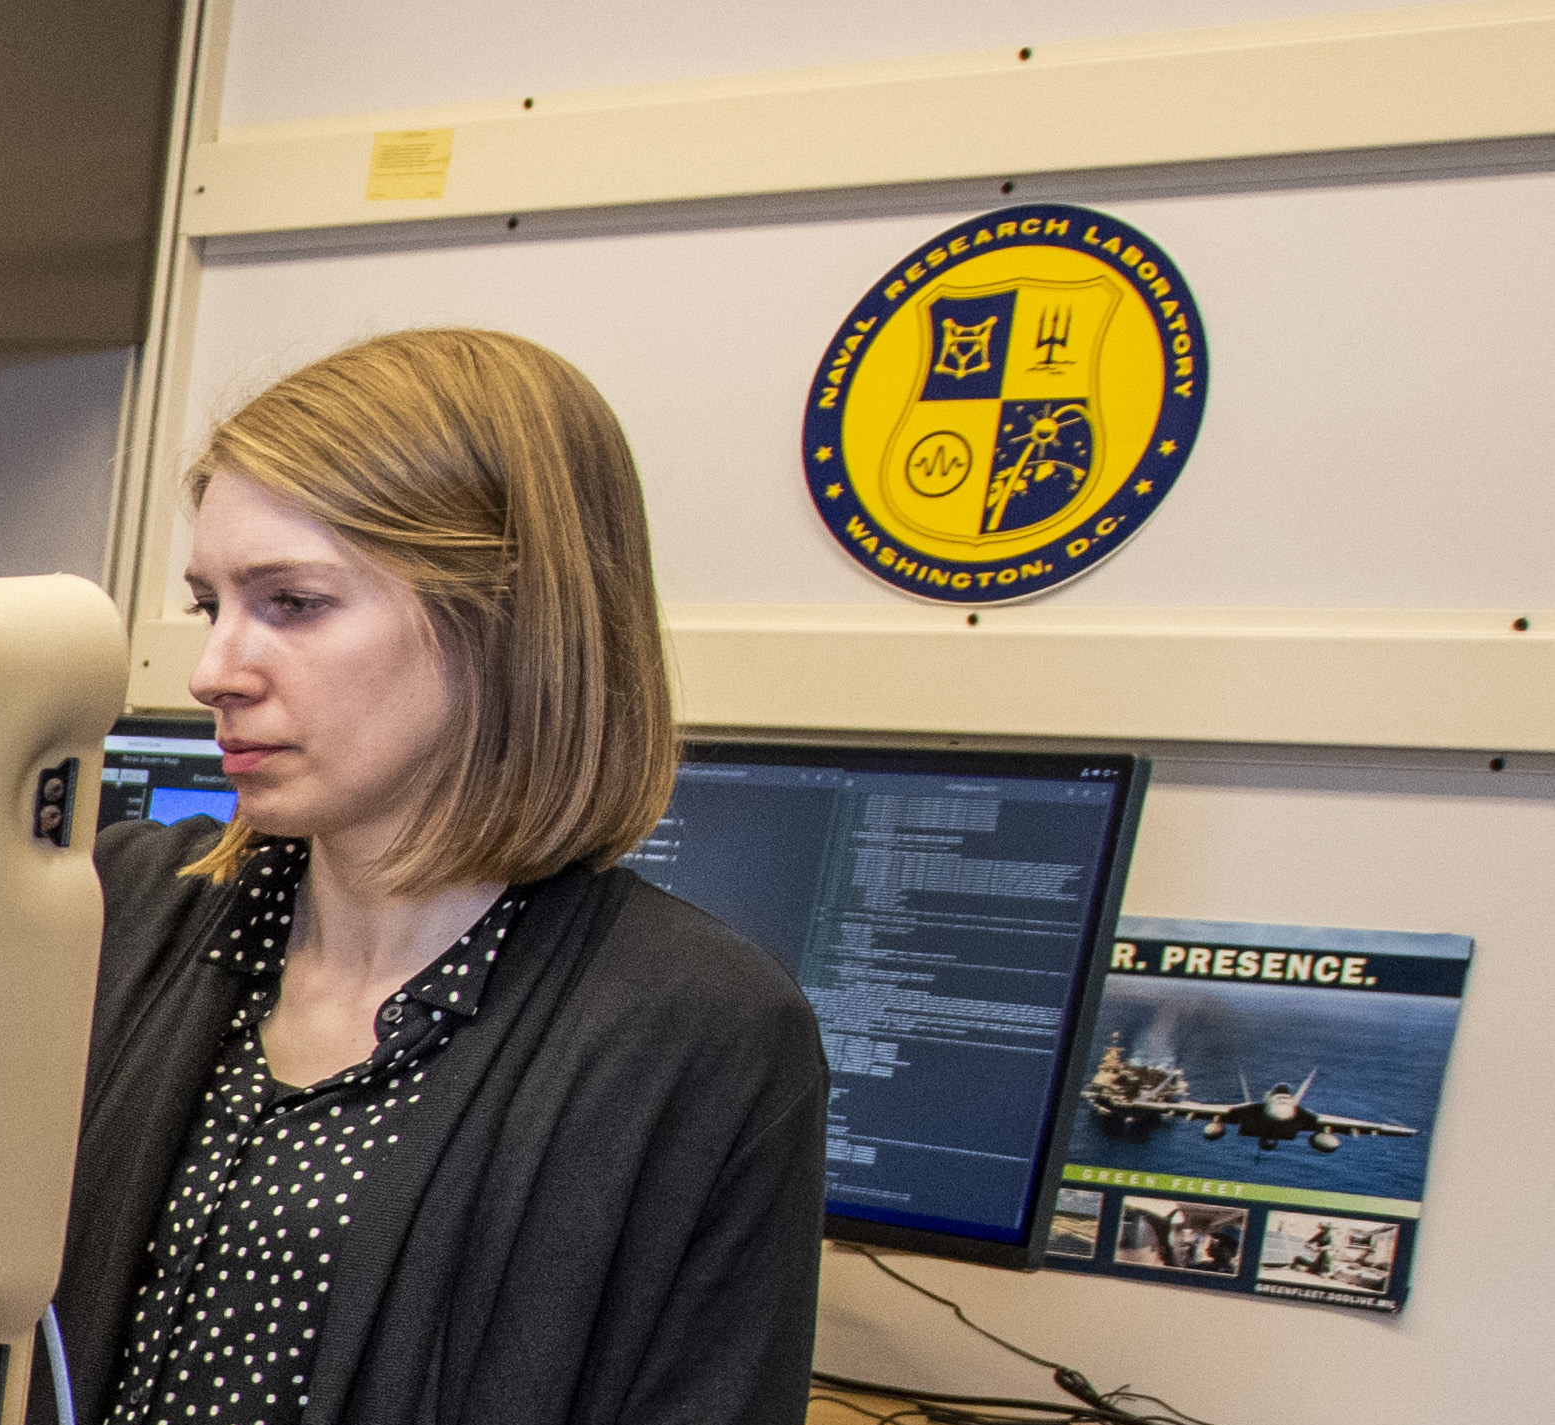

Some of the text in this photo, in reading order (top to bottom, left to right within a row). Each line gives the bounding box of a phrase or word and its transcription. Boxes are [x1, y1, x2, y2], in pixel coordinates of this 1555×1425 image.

[819, 217, 1194, 409] NAVAL RESEARCH LABORATORY
[845, 514, 1127, 590] WASHINGTON, D.C.
[1159, 944, 1378, 986] PRESENCE.
[1082, 1169, 1244, 1196] GREEN FLEET
